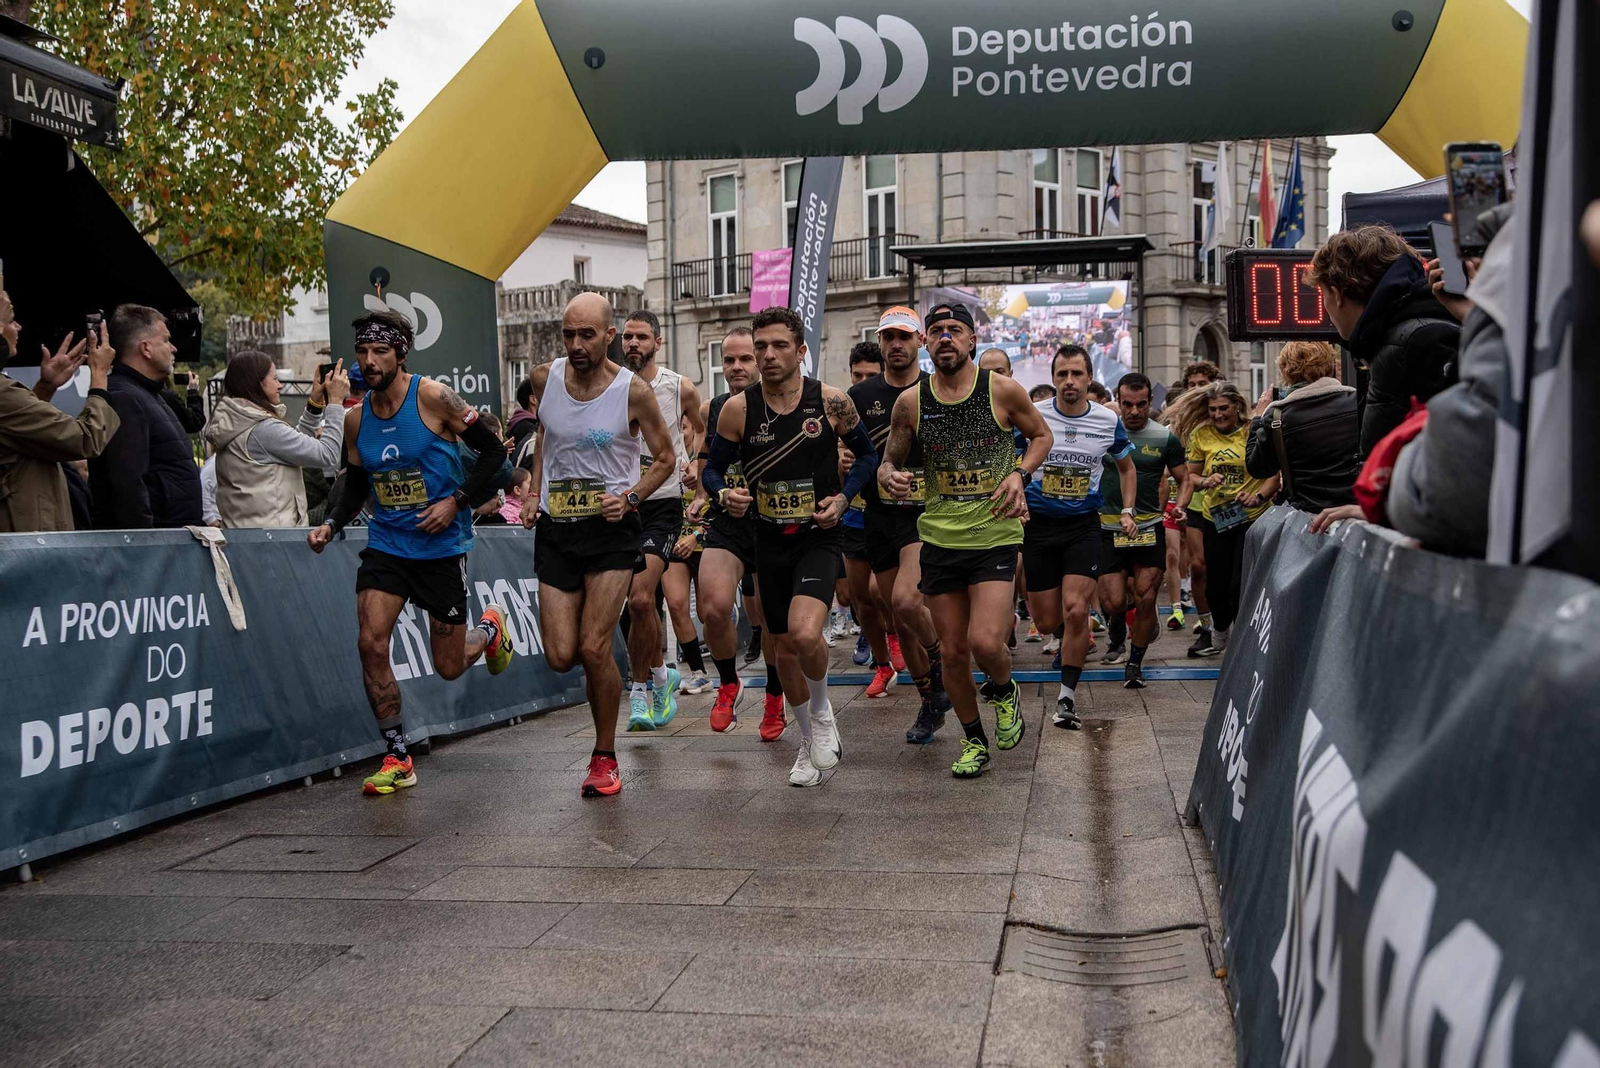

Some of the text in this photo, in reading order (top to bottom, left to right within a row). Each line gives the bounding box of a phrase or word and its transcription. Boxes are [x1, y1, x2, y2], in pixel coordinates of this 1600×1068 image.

[951, 11, 1194, 65] Deputación
[951, 56, 1194, 98] Pontevedra
[11, 72, 97, 127] LA SALVE
[804, 200, 828, 332] Pontevedra
[385, 483, 411, 498] 290
[948, 472, 980, 487] 244
[1060, 477, 1073, 489] 15
[567, 494, 588, 508] 44
[767, 494, 800, 510] 468
[22, 592, 210, 649] A PROVINCIA
[146, 642, 187, 683] DO
[20, 687, 213, 778] DEPORTE
